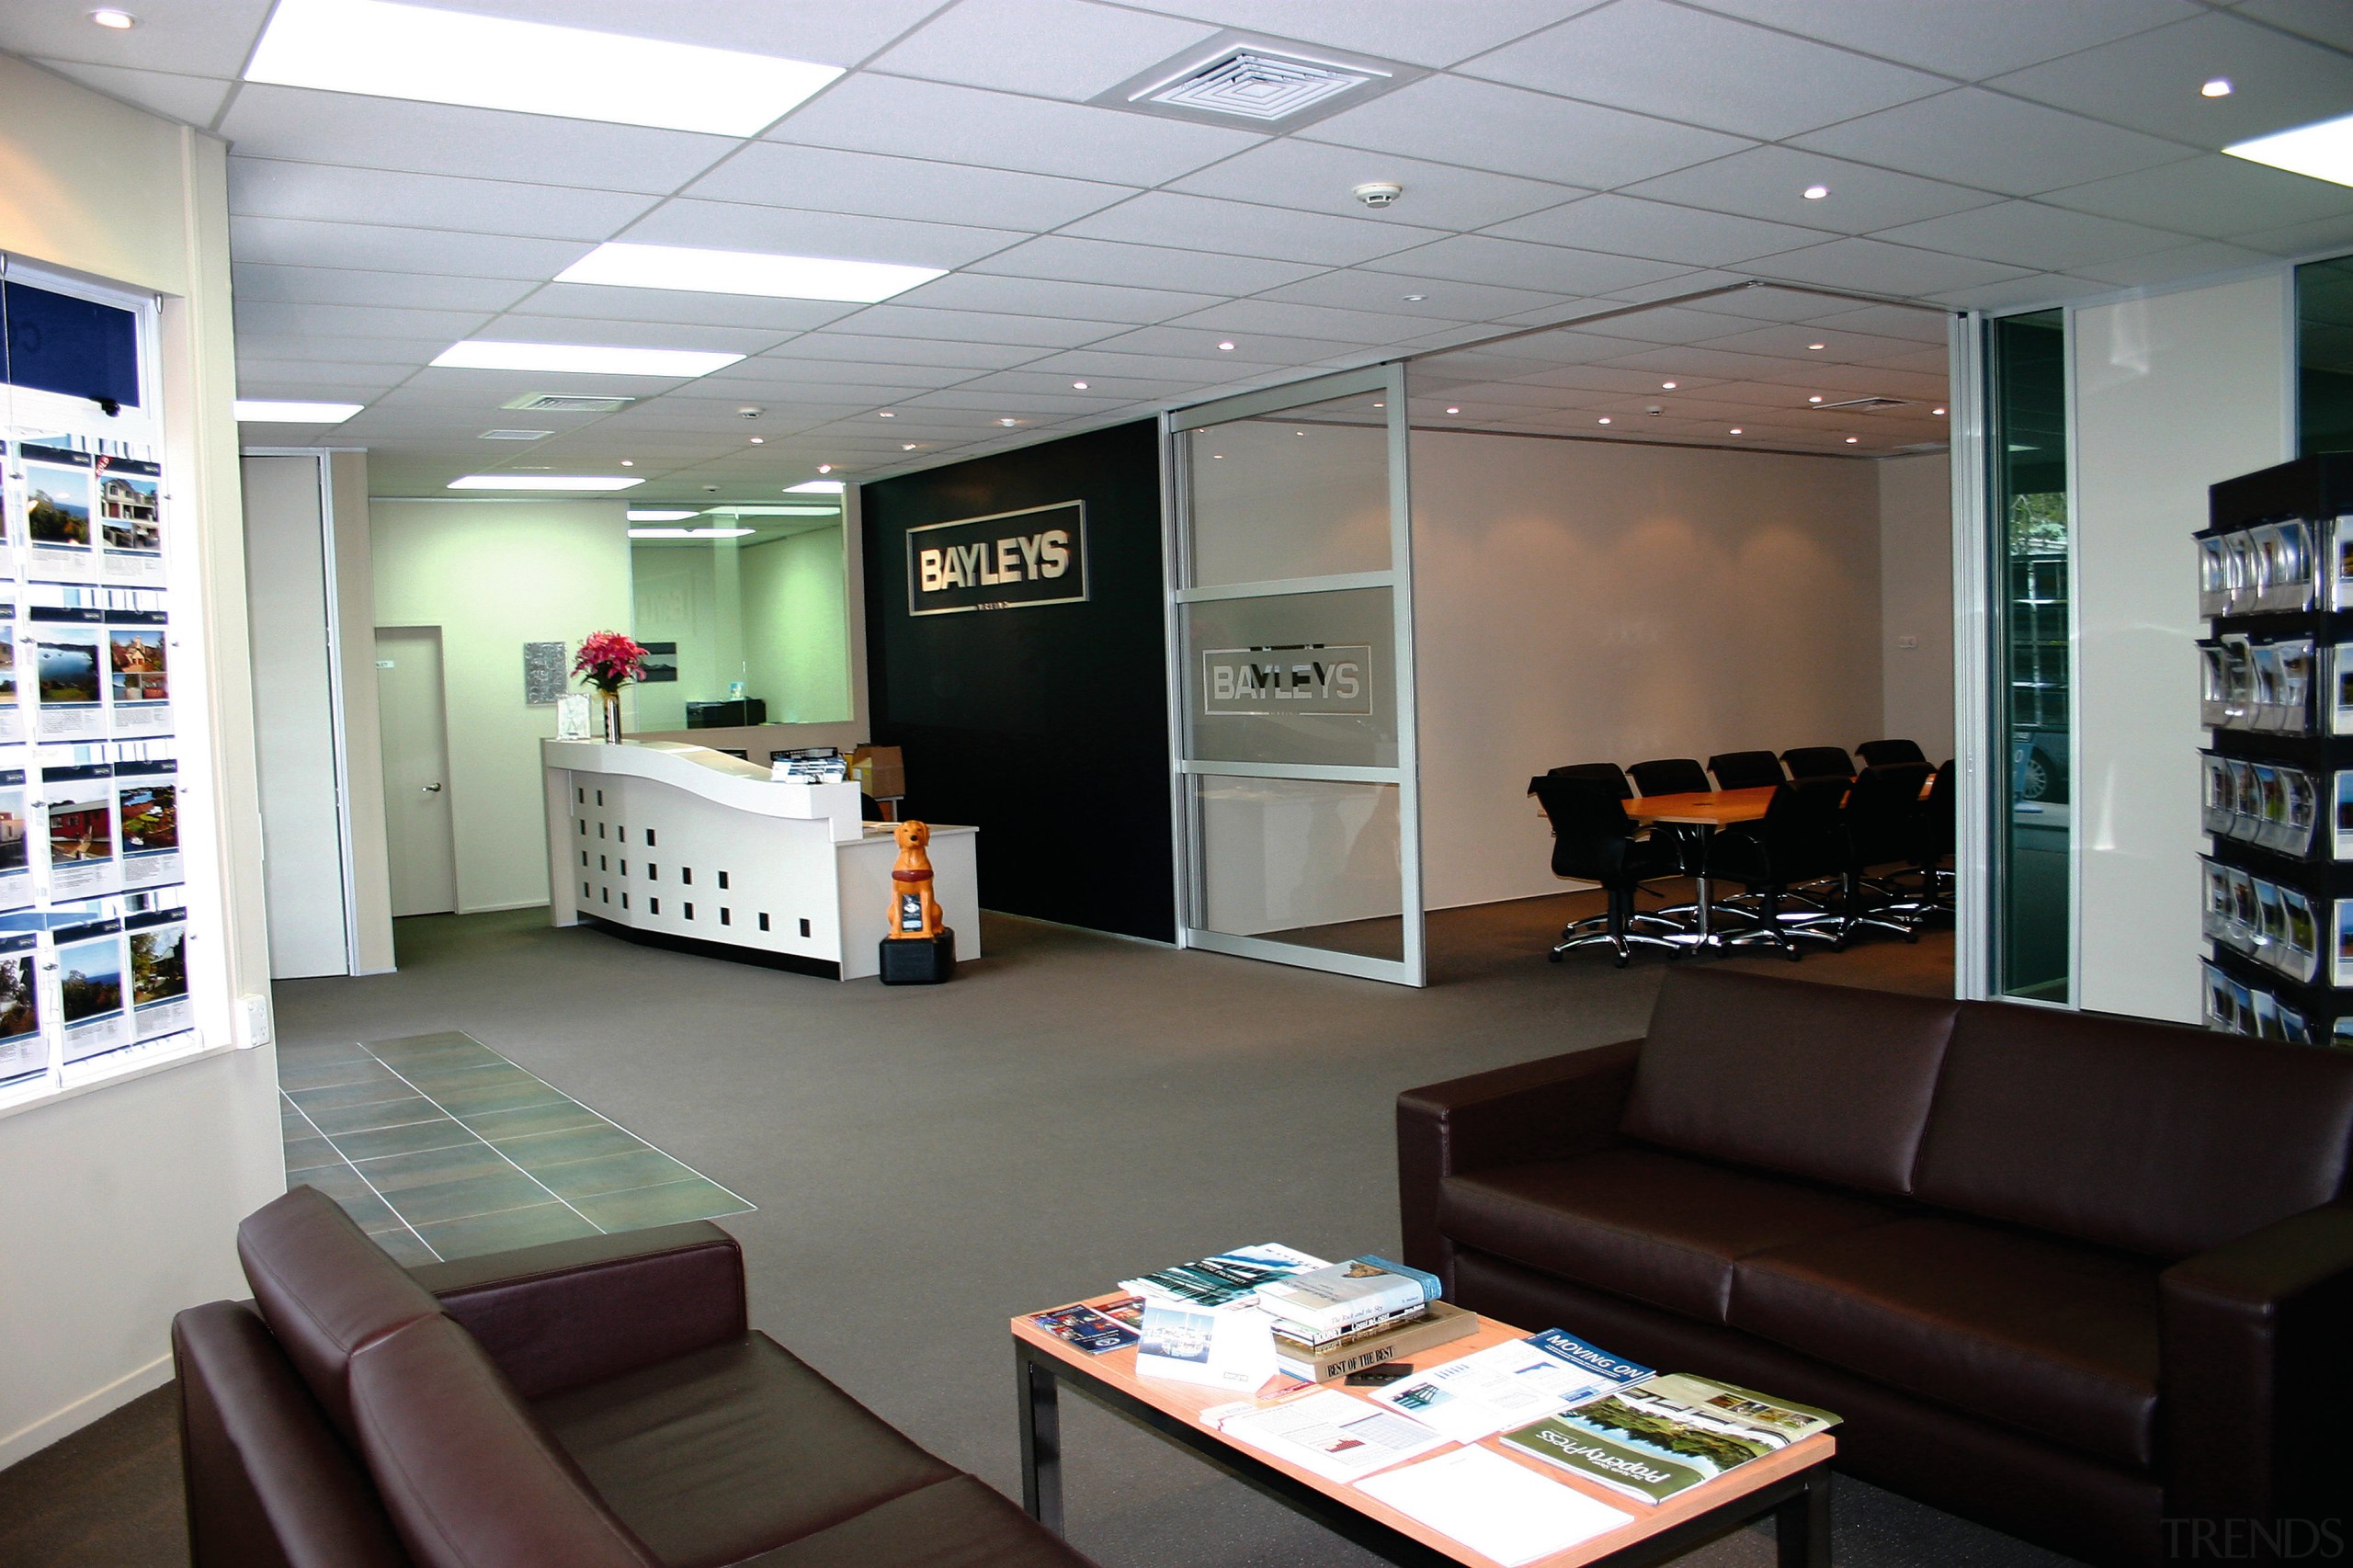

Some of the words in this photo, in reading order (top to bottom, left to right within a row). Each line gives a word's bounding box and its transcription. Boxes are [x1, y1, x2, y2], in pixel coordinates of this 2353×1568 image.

[97, 457, 110, 476] SOLD
[920, 530, 1069, 592] BAYLEYS
[1213, 653, 1359, 699] BAYLEYS
[1327, 1361, 1347, 1378] BEST
[1347, 1357, 1358, 1370] OF
[1359, 1353, 1375, 1367] THE
[1376, 1346, 1393, 1362] BEST
[1546, 1335, 1616, 1369] MOVING
[1613, 1365, 1644, 1379] ON
[1536, 1430, 1671, 1484] PropertyPress
